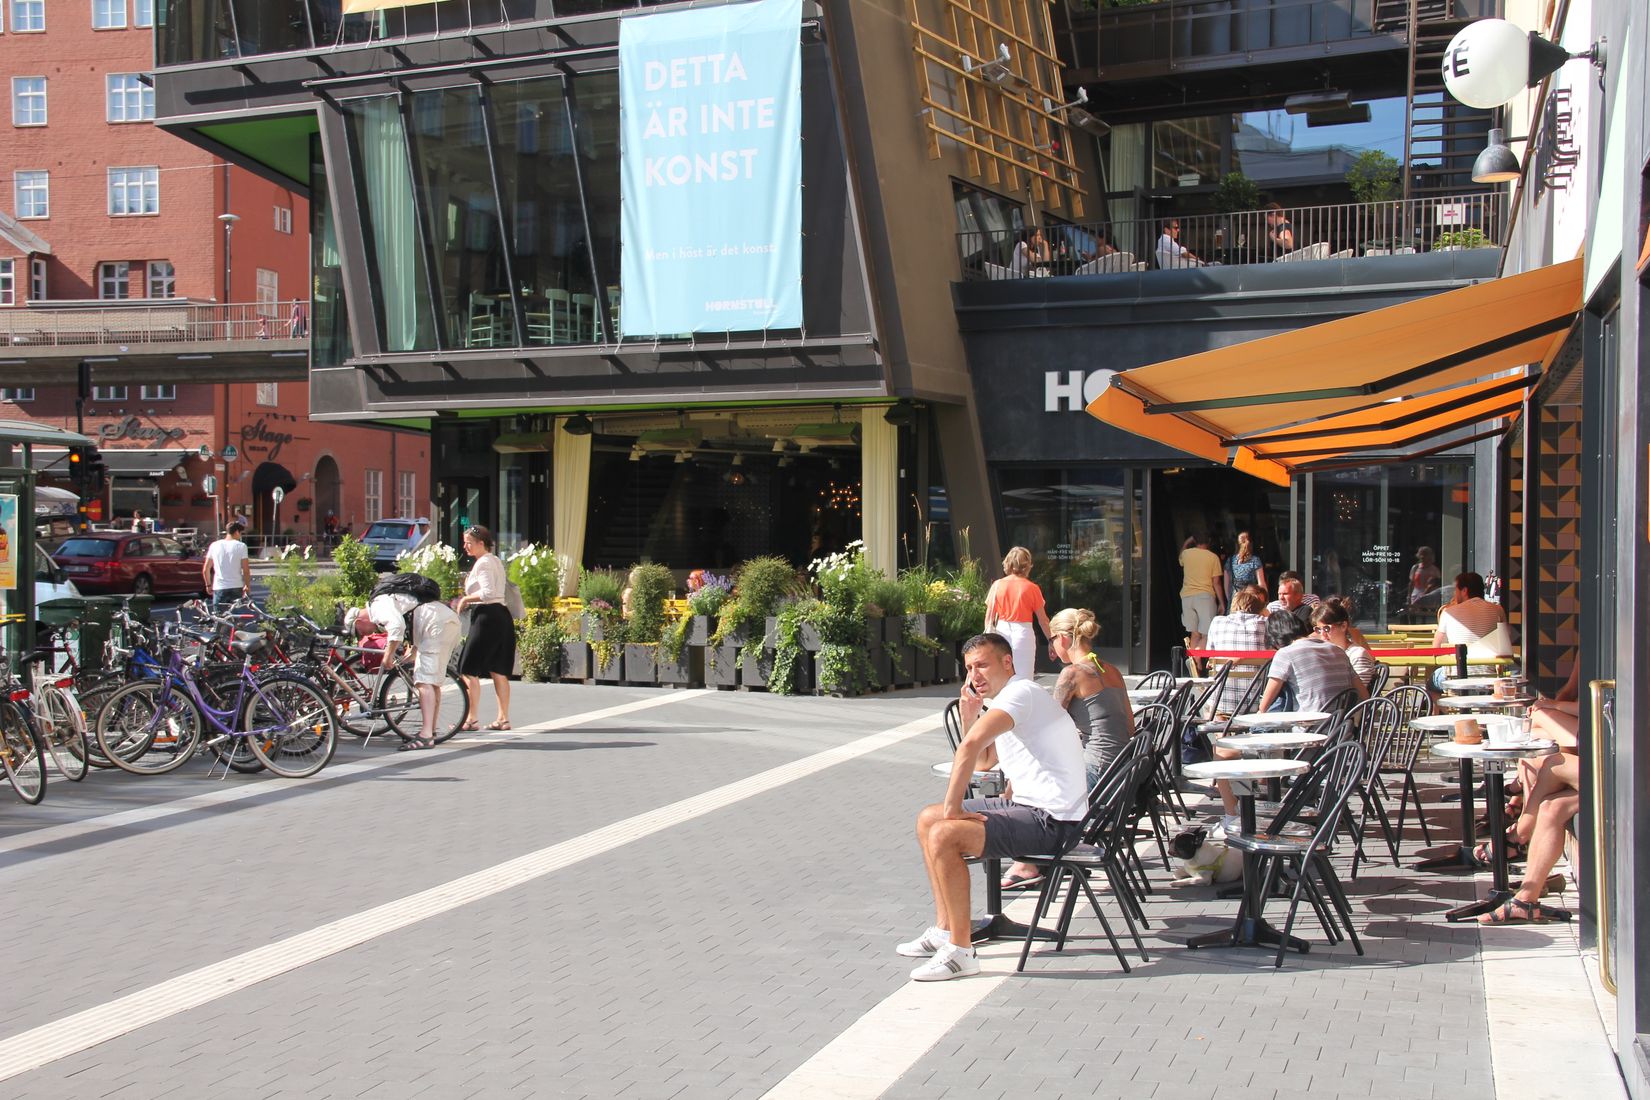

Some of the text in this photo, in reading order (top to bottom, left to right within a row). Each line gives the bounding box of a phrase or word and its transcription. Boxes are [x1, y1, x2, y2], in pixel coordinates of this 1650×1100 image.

[644, 51, 748, 91] DETTA
[642, 97, 775, 139] ÄR INTE
[644, 147, 759, 187] KONST
[645, 250, 669, 261] Men
[679, 246, 704, 259] höst
[706, 245, 719, 257] är
[721, 243, 741, 256] det
[98, 414, 188, 449] Stage
[241, 418, 294, 461] Stage
